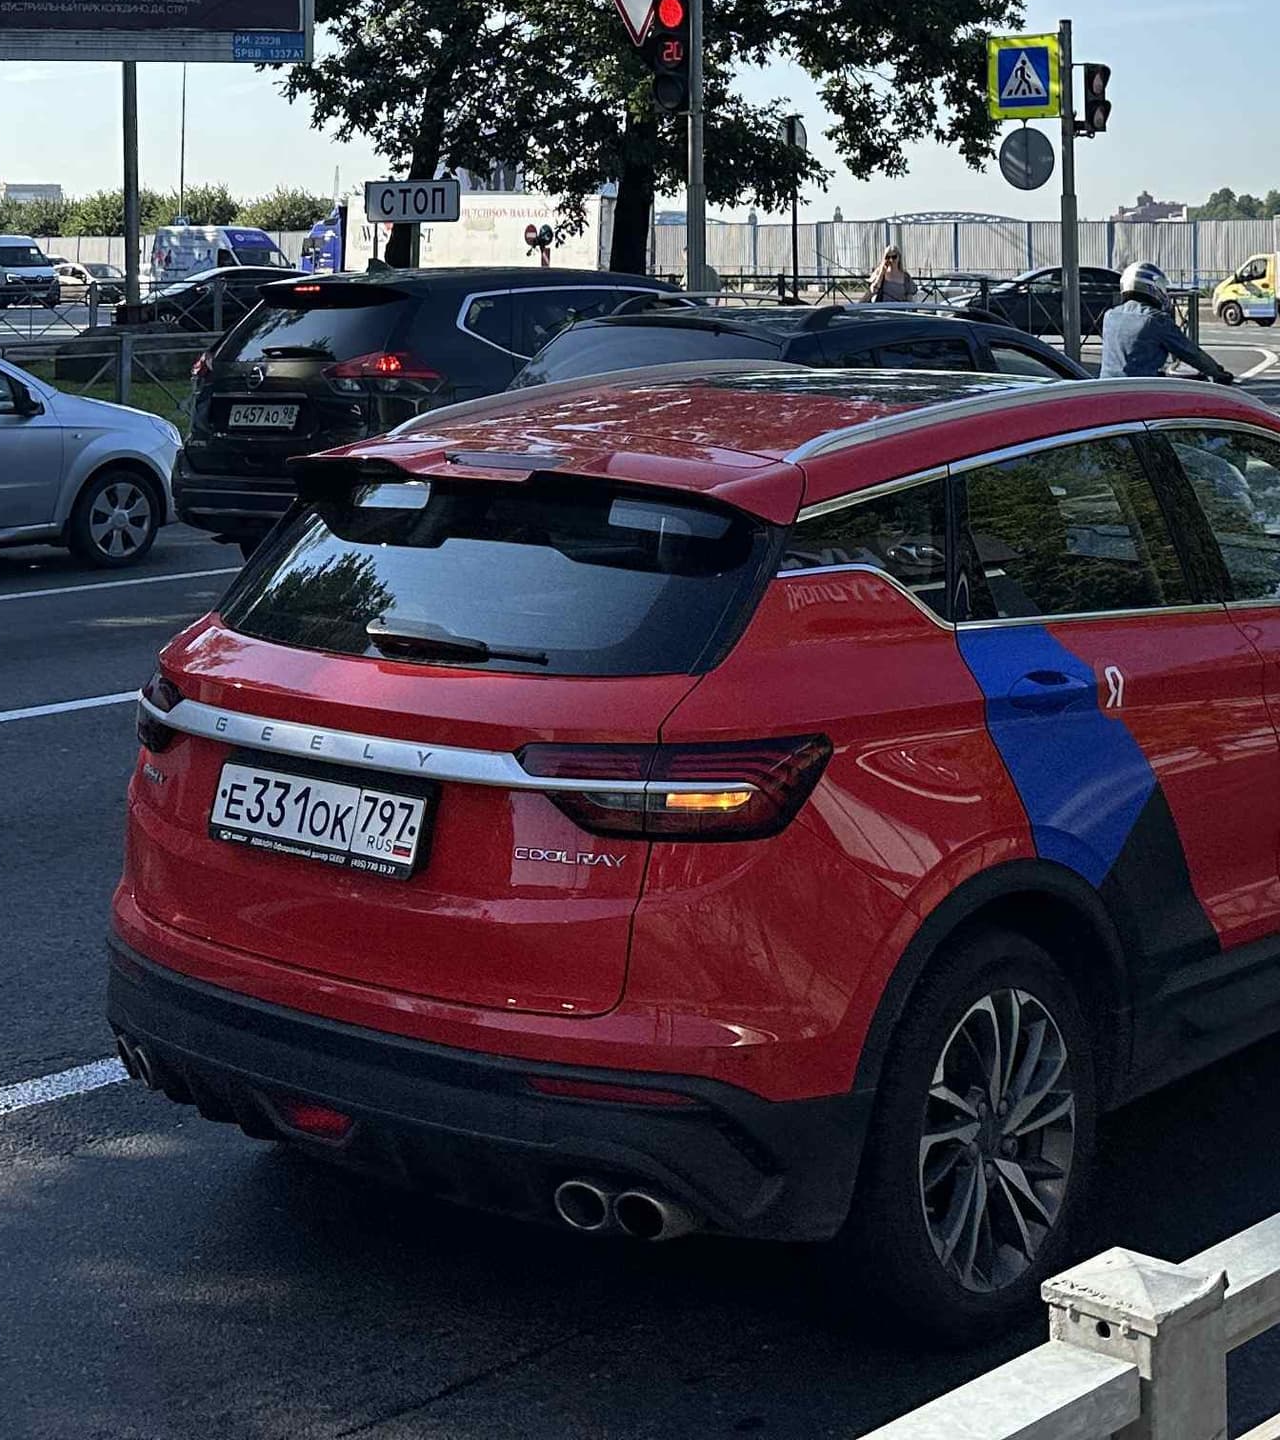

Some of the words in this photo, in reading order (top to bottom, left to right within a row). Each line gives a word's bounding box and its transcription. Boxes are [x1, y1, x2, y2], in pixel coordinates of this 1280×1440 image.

[381, 188, 446, 215] СТОП
[1104, 666, 1124, 709] Я
[215, 716, 433, 768] GEELY
[225, 777, 354, 843] Е331ОК
[361, 795, 415, 841] 797
[367, 836, 392, 853] RUS
[514, 847, 627, 868] COOLRAY
